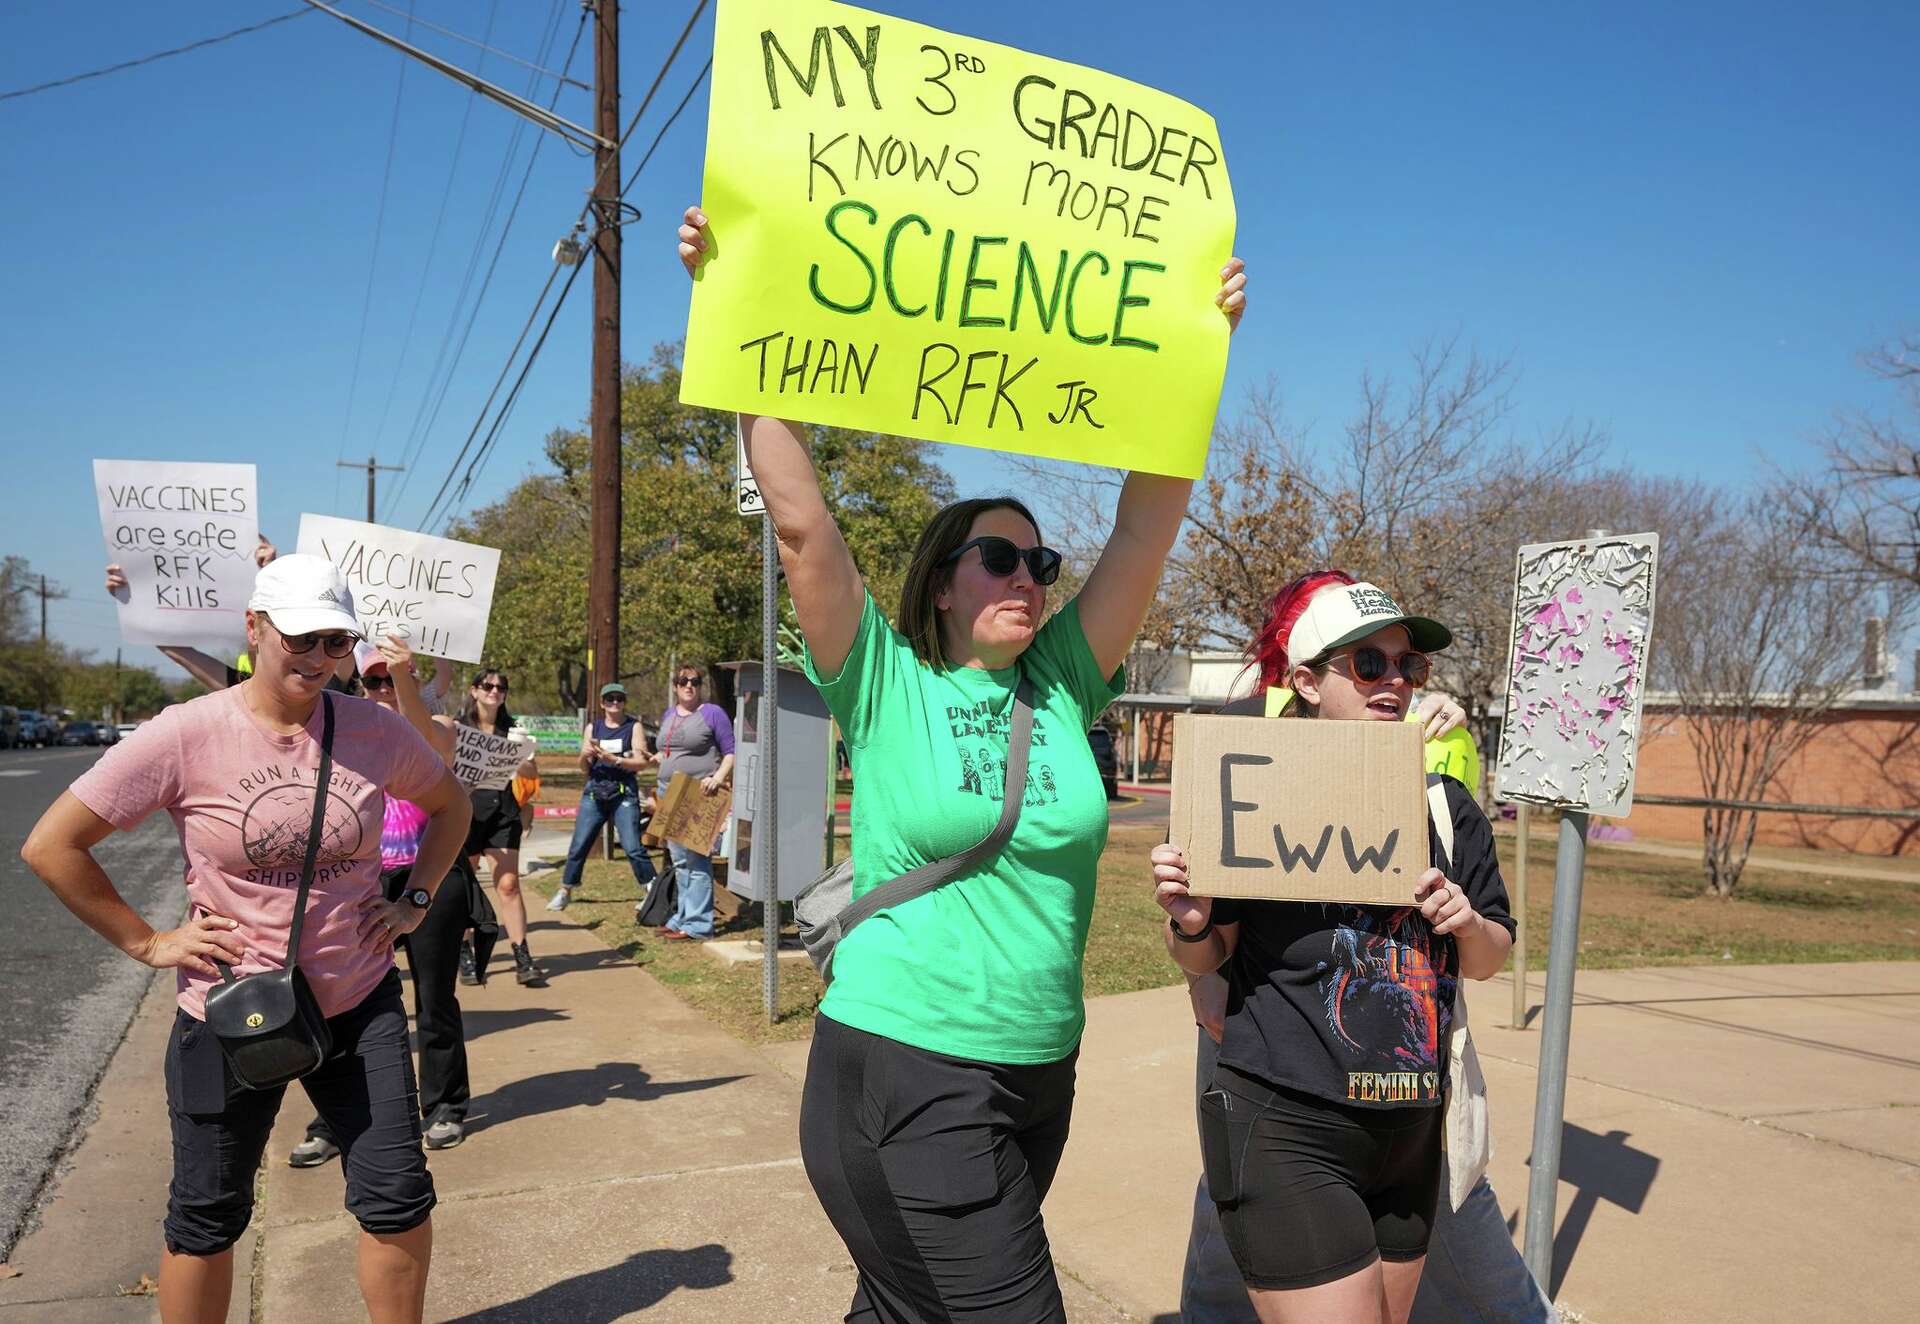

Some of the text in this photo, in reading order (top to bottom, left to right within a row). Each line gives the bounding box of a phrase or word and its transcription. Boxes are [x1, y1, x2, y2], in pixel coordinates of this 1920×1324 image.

[760, 25, 1218, 200] MY 3RD GRADER
[808, 132, 1170, 243] KNOWS MORE
[808, 200, 1166, 352] SCIENCE
[740, 331, 1104, 431] THAN RFK JR
[108, 486, 247, 513] VACCINES
[116, 522, 237, 551] are safe
[154, 554, 217, 582] RFK
[321, 538, 478, 599] VACCINES
[356, 594, 424, 620] SAVE
[239, 764, 282, 794] RUN
[291, 766, 301, 780] A
[312, 767, 363, 797] TGHT
[1219, 752, 1402, 874] Eww.
[246, 860, 360, 887] SHIPRECK
